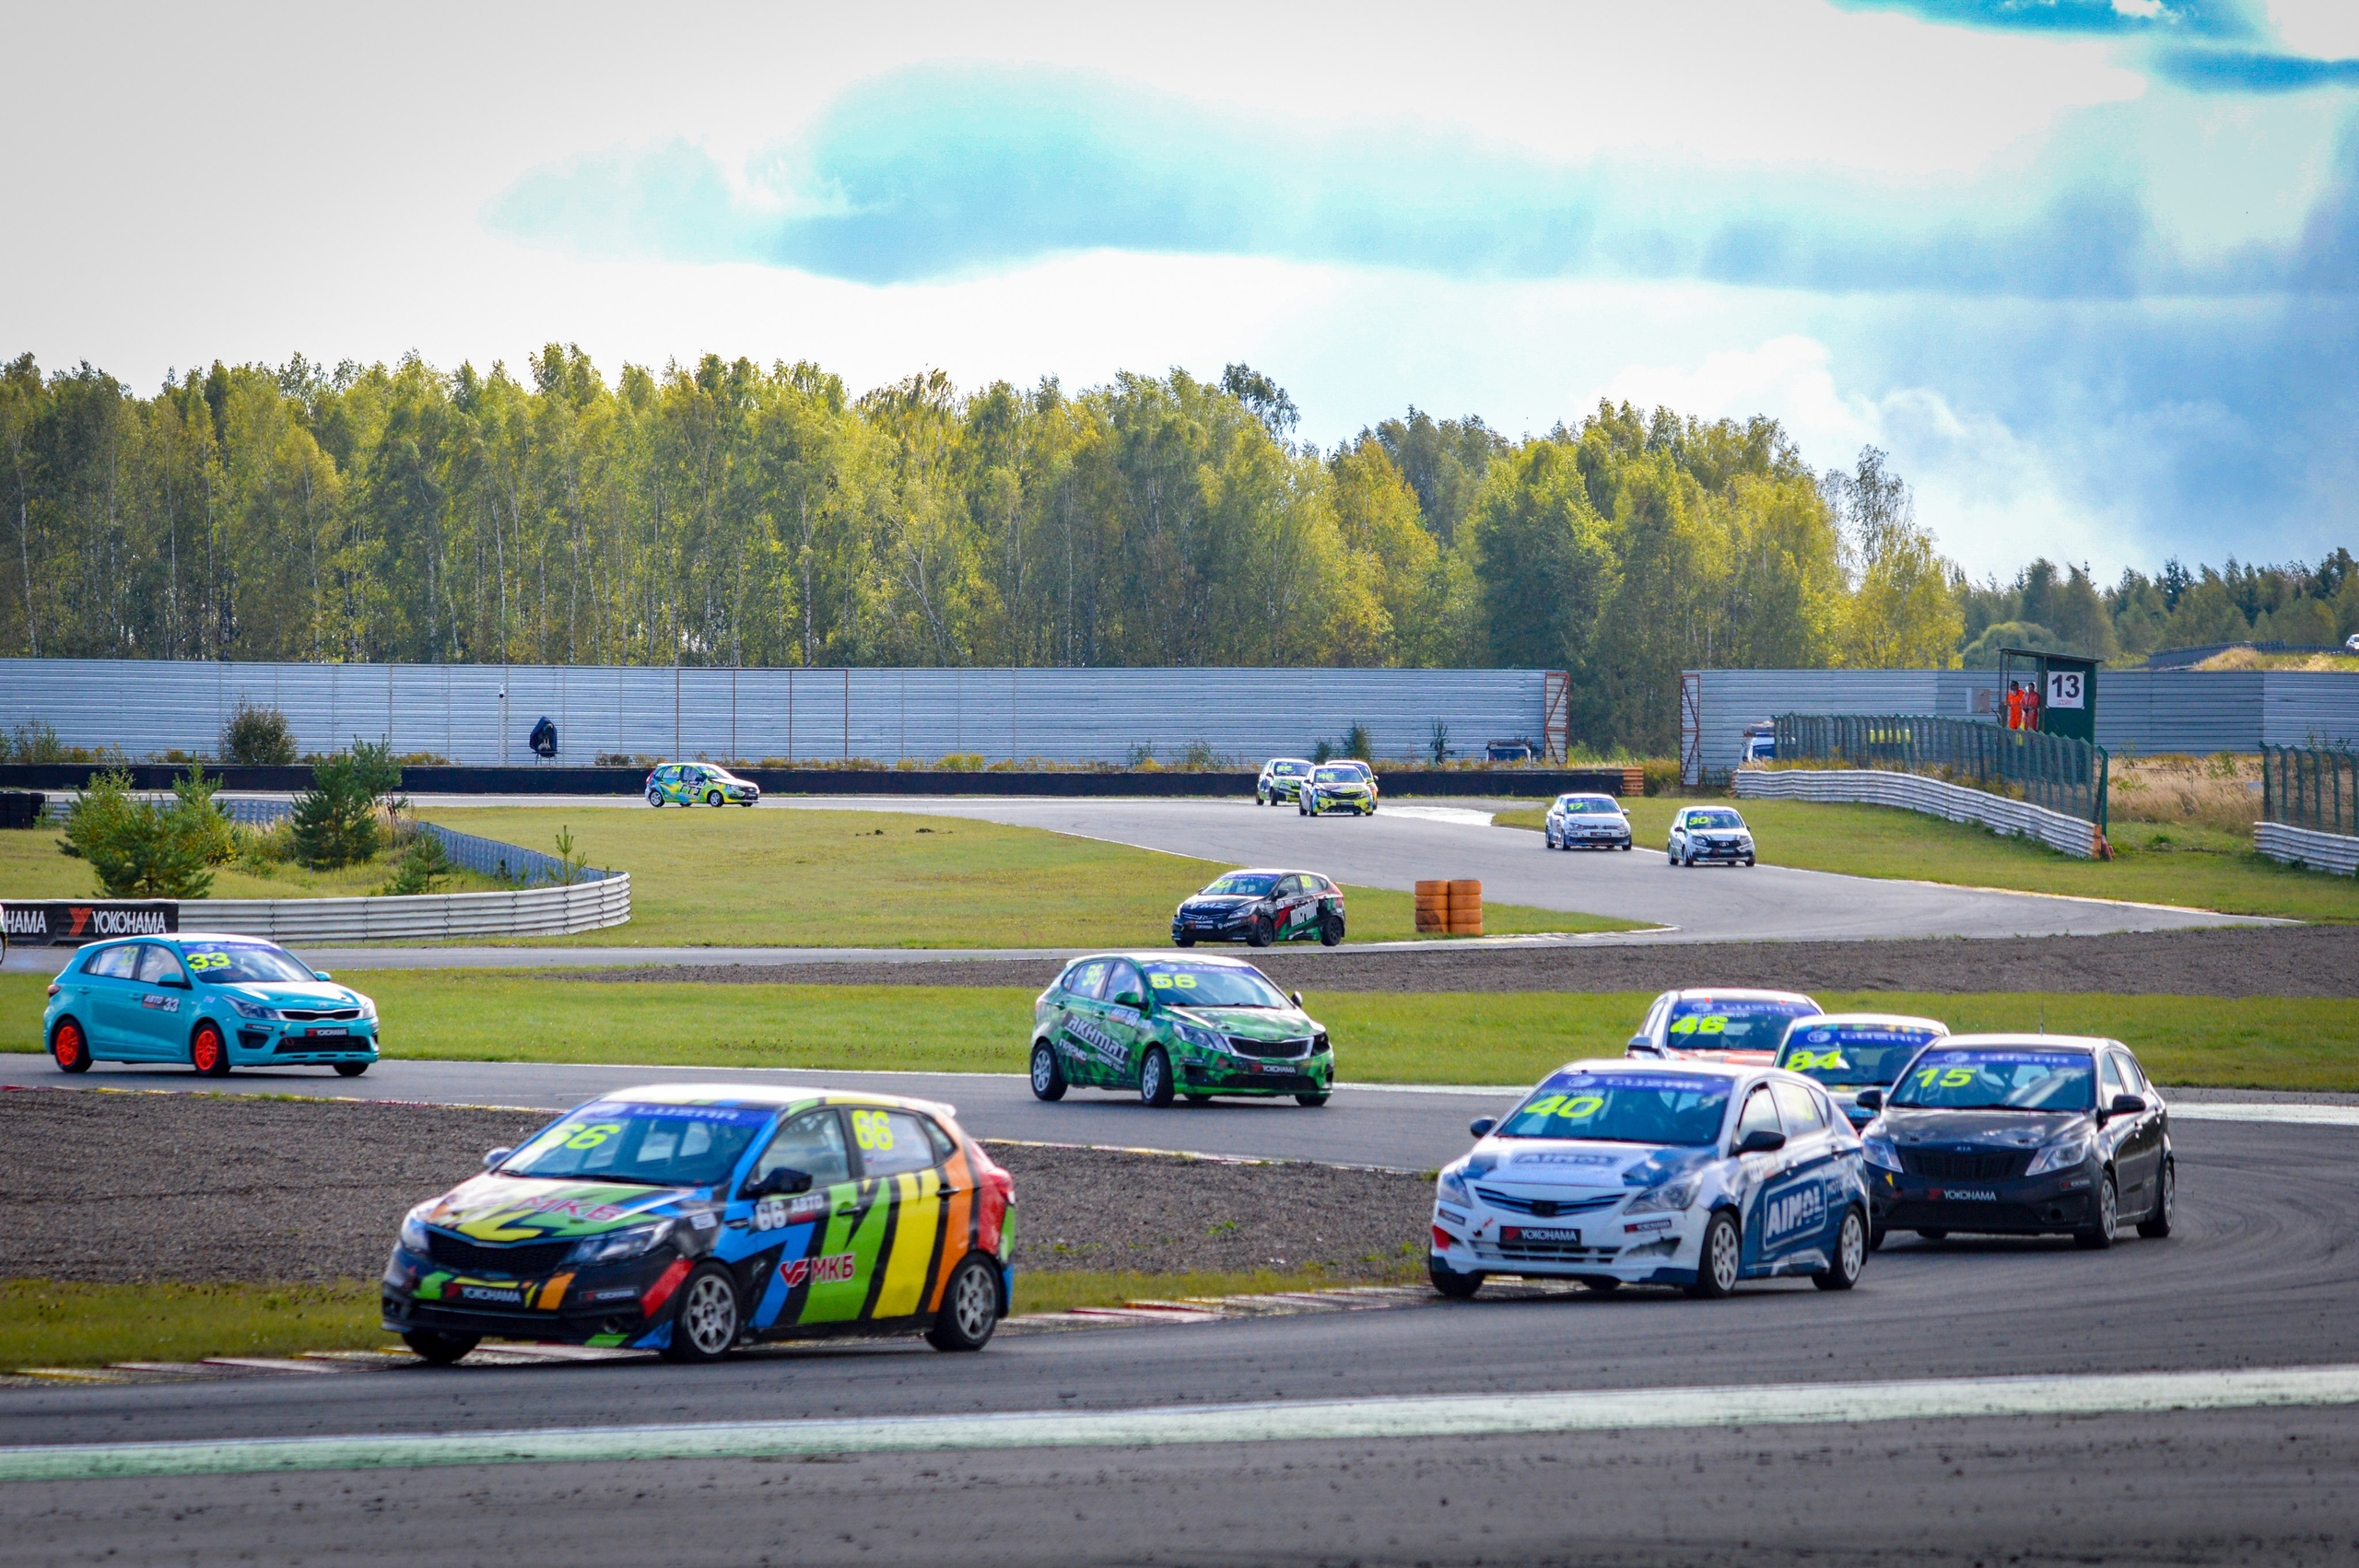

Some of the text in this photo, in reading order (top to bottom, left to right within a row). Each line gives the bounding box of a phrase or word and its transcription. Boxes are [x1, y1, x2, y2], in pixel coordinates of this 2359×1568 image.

[2051, 674, 2081, 698] 13
[92, 911, 167, 934] YOKOHAMA
[186, 952, 231, 969] 33
[1150, 973, 1197, 989] 56
[163, 997, 180, 1012] 33
[1670, 1016, 1729, 1034] 46
[1262, 1065, 1297, 1073] YOKOHAMA
[1785, 1050, 1842, 1071] 84
[1917, 1069, 1978, 1087] 15
[1523, 1095, 1603, 1117] 40
[851, 1109, 894, 1151] 66
[1943, 1189, 1997, 1201] YOKOHAMA
[756, 1200, 788, 1232] 66
[1766, 1185, 1824, 1239] AIMOL
[1520, 1229, 1578, 1242] YOKOHAMA
[810, 1251, 857, 1286] МКБ
[462, 1286, 522, 1304] YOKOHAMA
